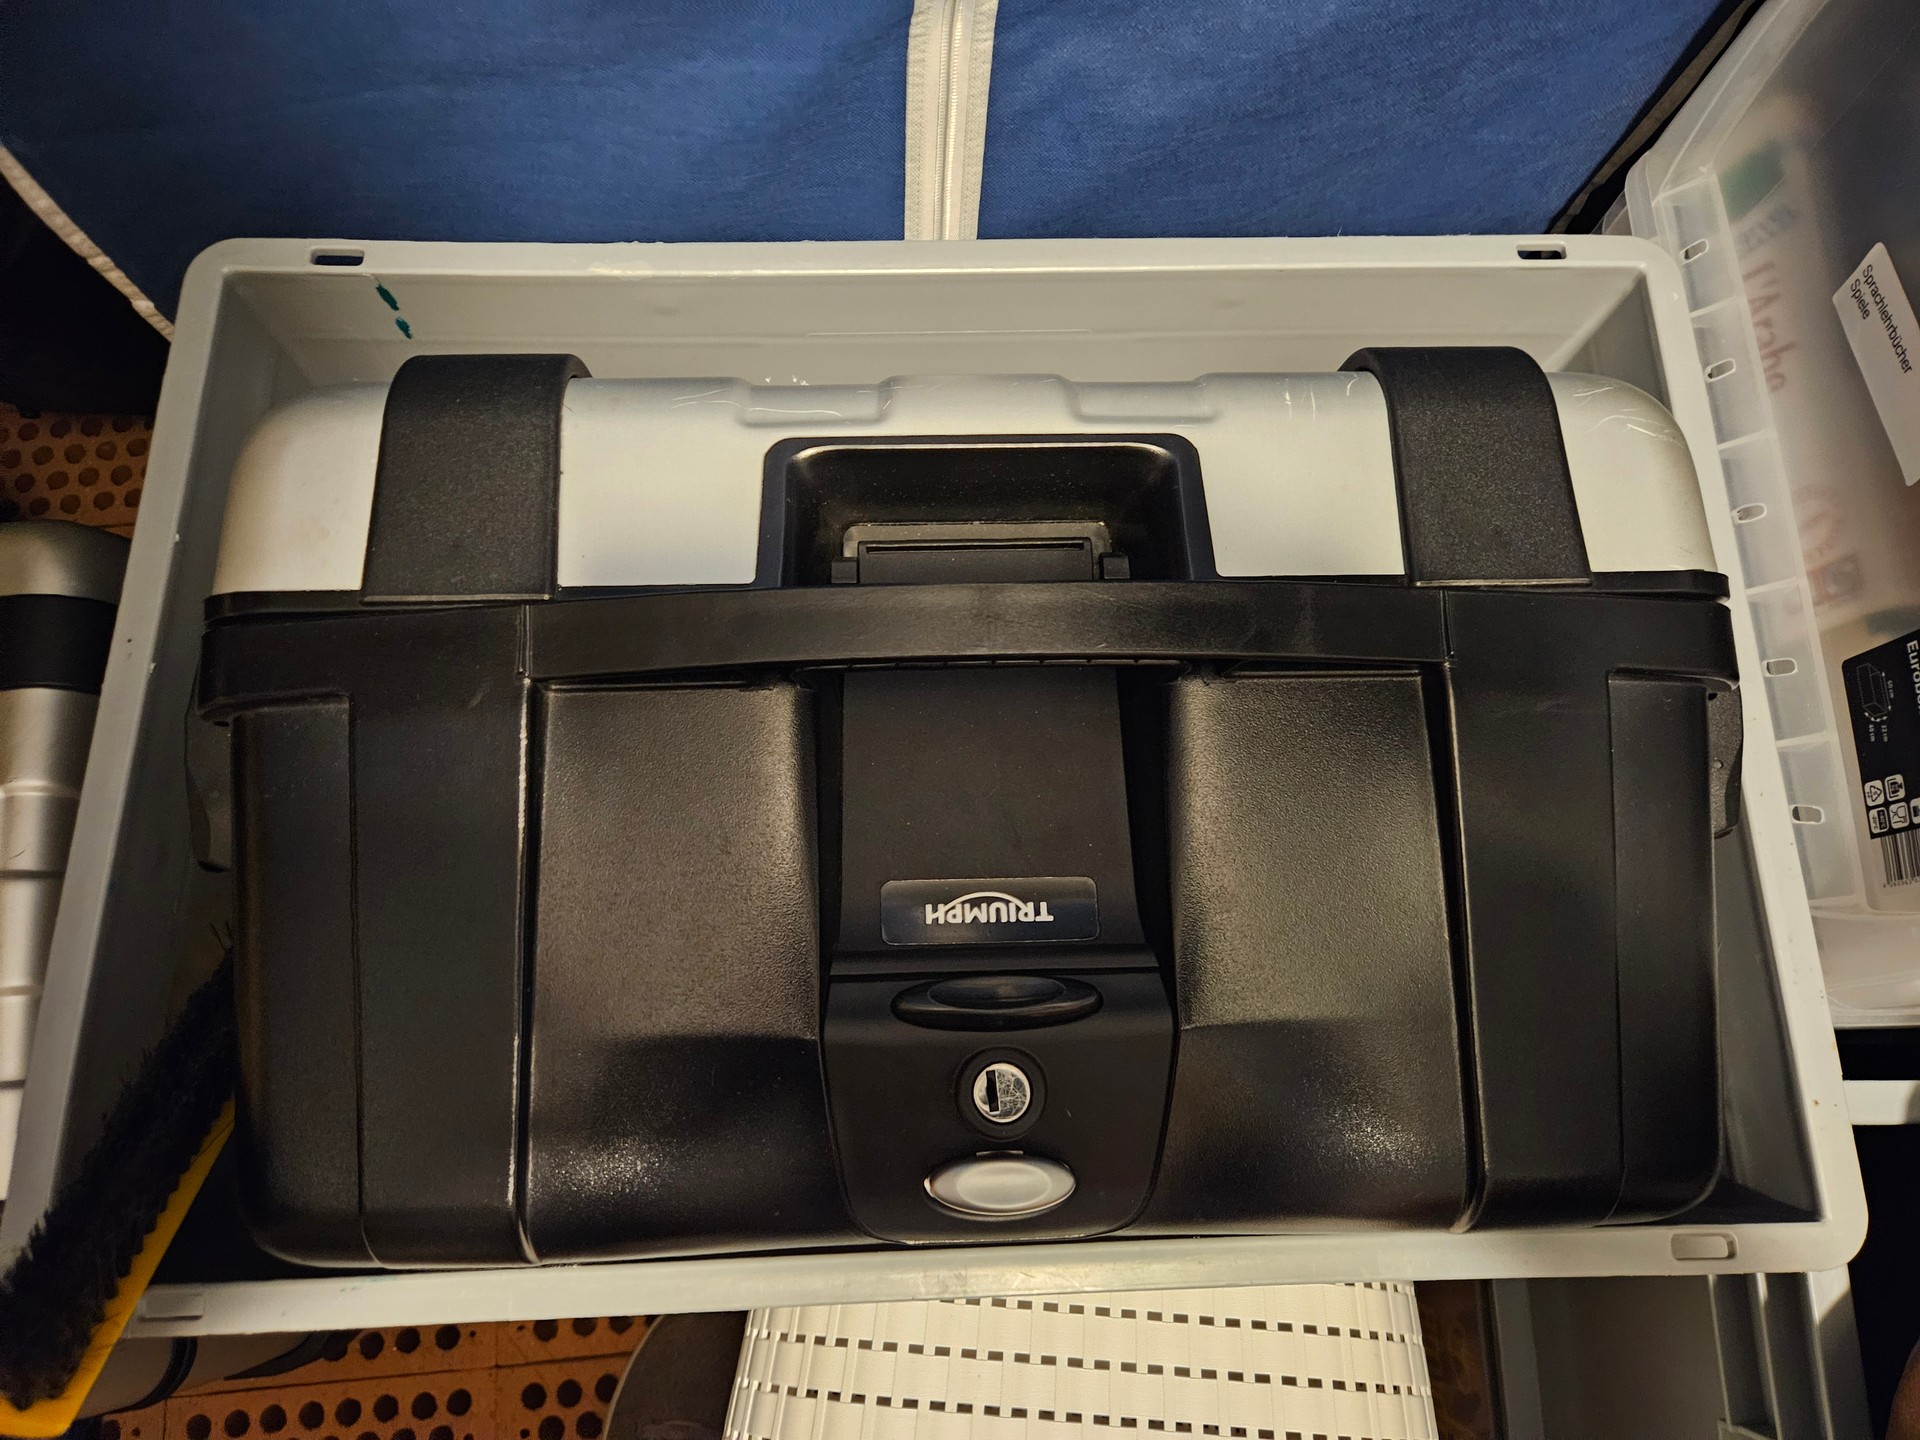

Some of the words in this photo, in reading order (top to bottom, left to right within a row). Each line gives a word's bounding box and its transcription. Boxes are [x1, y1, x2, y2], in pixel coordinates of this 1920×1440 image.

[1850, 278, 1870, 320] Spiele
[1862, 264, 1912, 374] Sprachlehrbücher
[1907, 640, 1920, 715] Euro
[925, 891, 1054, 925] TRIUMPH
